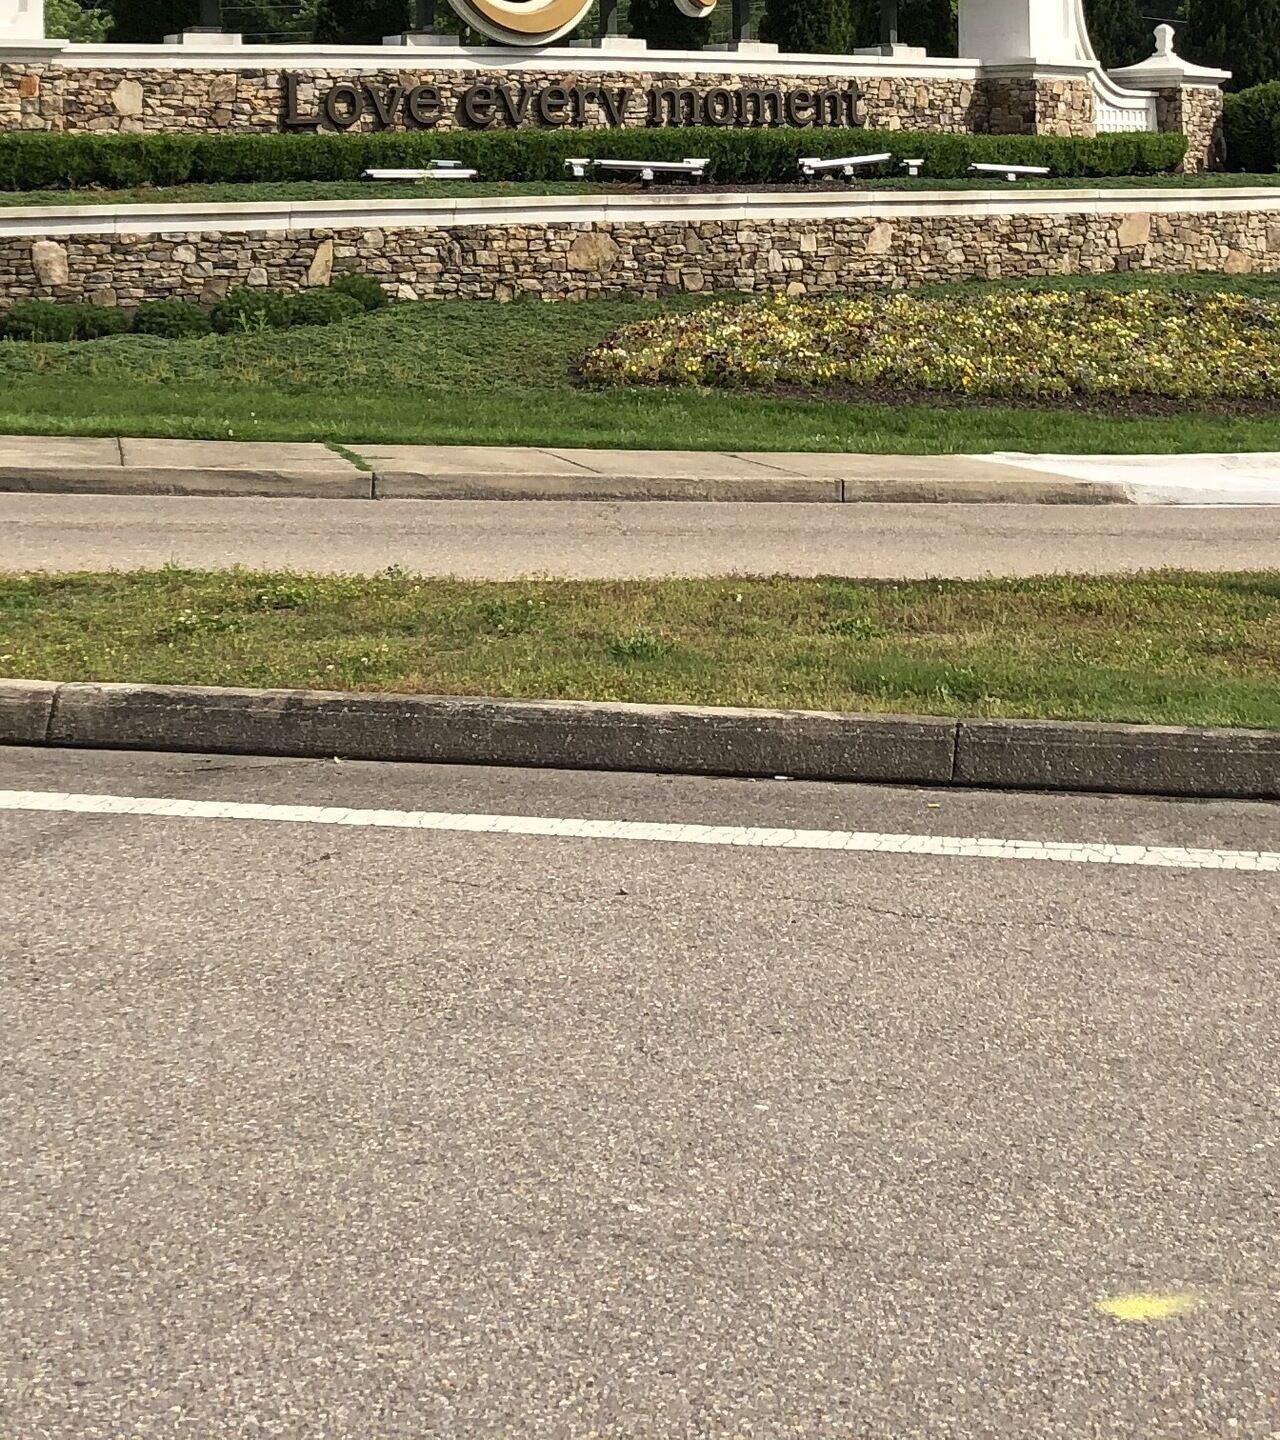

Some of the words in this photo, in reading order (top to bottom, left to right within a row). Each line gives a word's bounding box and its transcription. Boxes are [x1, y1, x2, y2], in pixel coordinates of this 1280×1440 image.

[283, 72, 441, 129] Love
[464, 83, 633, 130] every
[649, 79, 868, 128] moment
